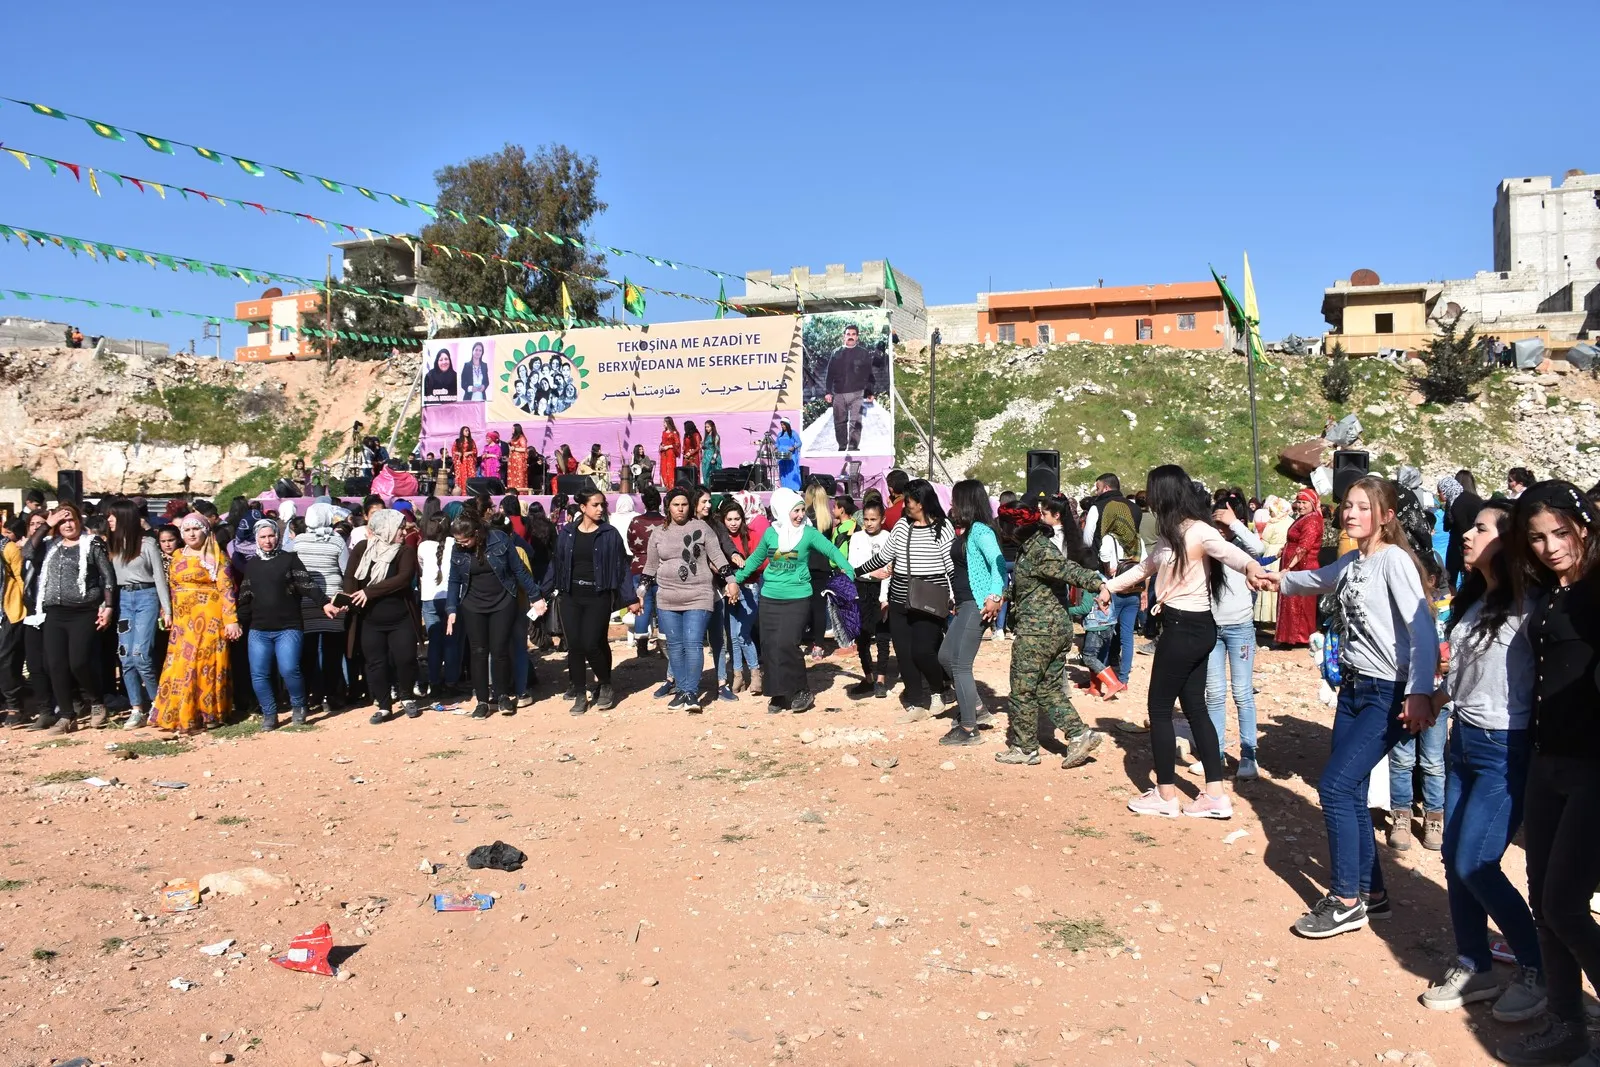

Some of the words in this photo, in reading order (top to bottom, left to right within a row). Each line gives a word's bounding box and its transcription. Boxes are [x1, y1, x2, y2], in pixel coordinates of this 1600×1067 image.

[617, 338, 678, 353] TEKOŞÎNA
[681, 338, 700, 348] ME
[703, 333, 742, 347] AZADÎ
[745, 334, 761, 345] YE
[598, 358, 684, 373] BERXWEDANA
[687, 357, 705, 368] ME
[709, 353, 777, 366] SERKEFTIN
[781, 352, 788, 363] E
[634, 385, 680, 398] مقاومتنا
[701, 383, 743, 395] حرية
[747, 379, 788, 391] نضالنا
[601, 387, 631, 401] نصر
